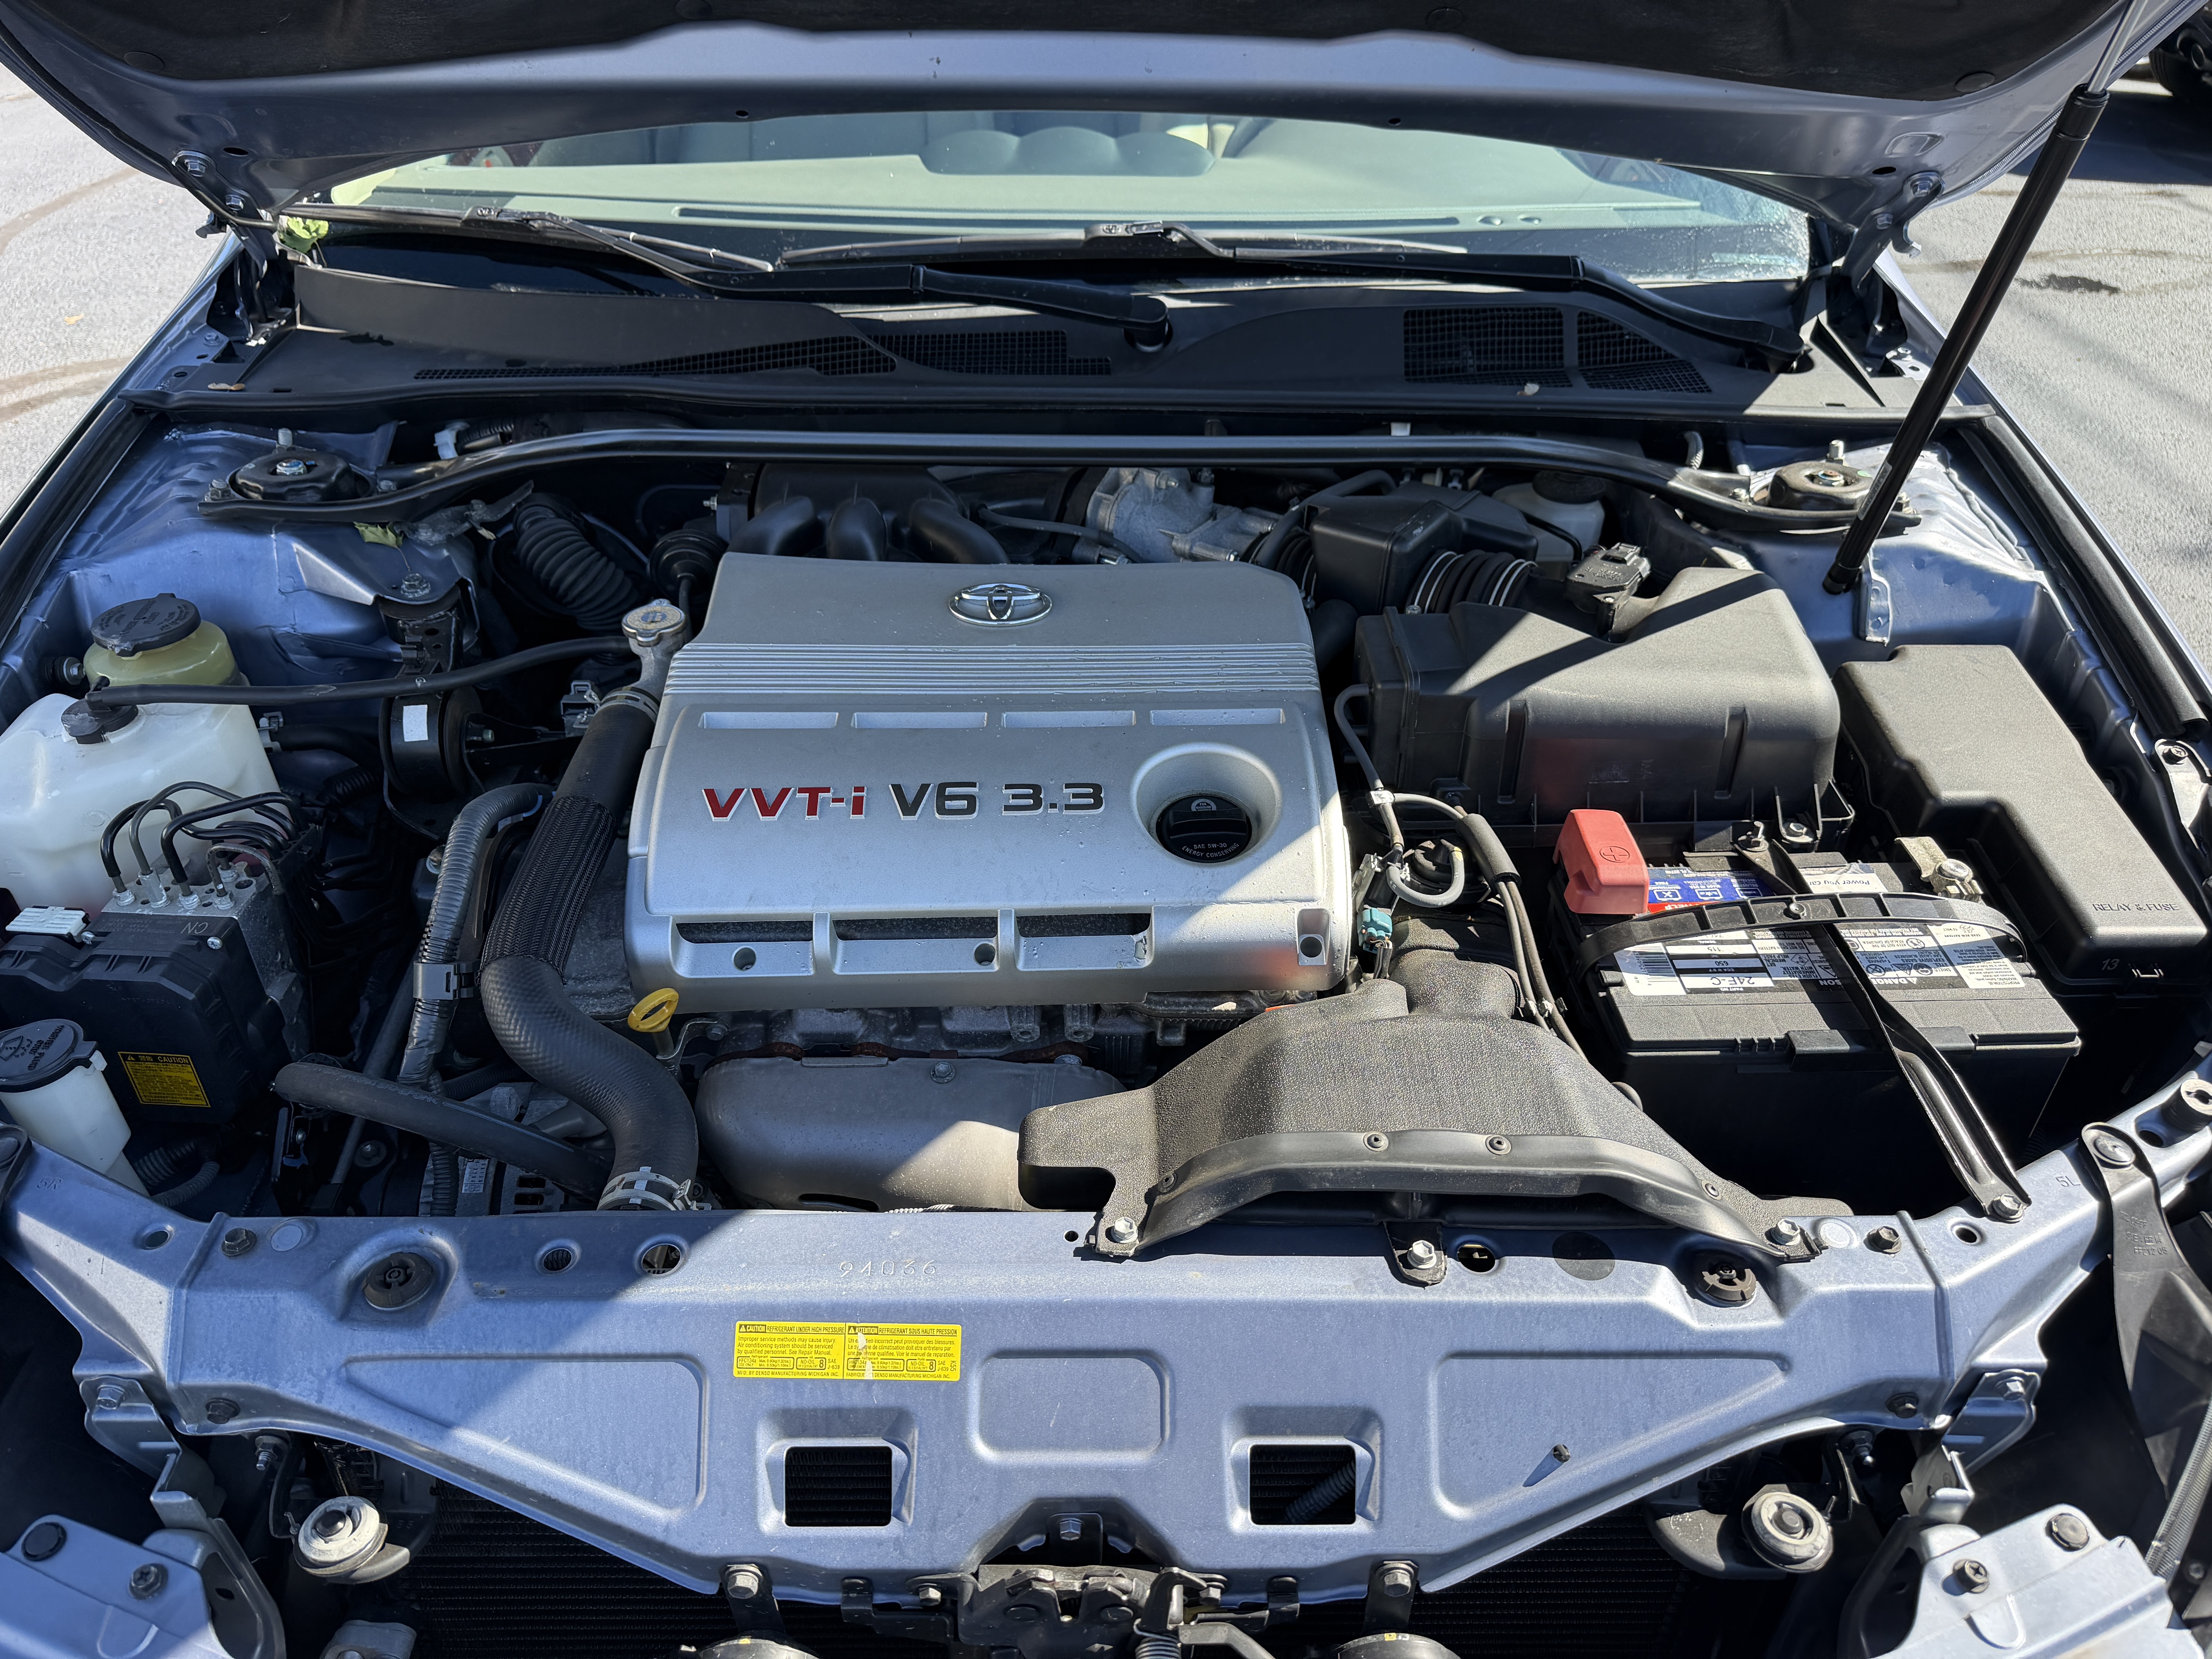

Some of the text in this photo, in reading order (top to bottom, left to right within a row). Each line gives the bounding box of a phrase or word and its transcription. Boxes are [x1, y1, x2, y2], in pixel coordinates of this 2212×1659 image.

[702, 782, 1106, 821] VVT-i V6 3.3
[1182, 843, 1239, 858] ENERGY CONSERVING
[180, 922, 209, 934] CN
[2102, 958, 2119, 970] 13
[1710, 976, 1755, 986] 24F-C
[36, 1178, 62, 1190] 5R
[2056, 1176, 2081, 1188] 5L
[839, 1260, 938, 1278] 94036
[819, 1359, 824, 1368] 8
[929, 1361, 933, 1370] 8
